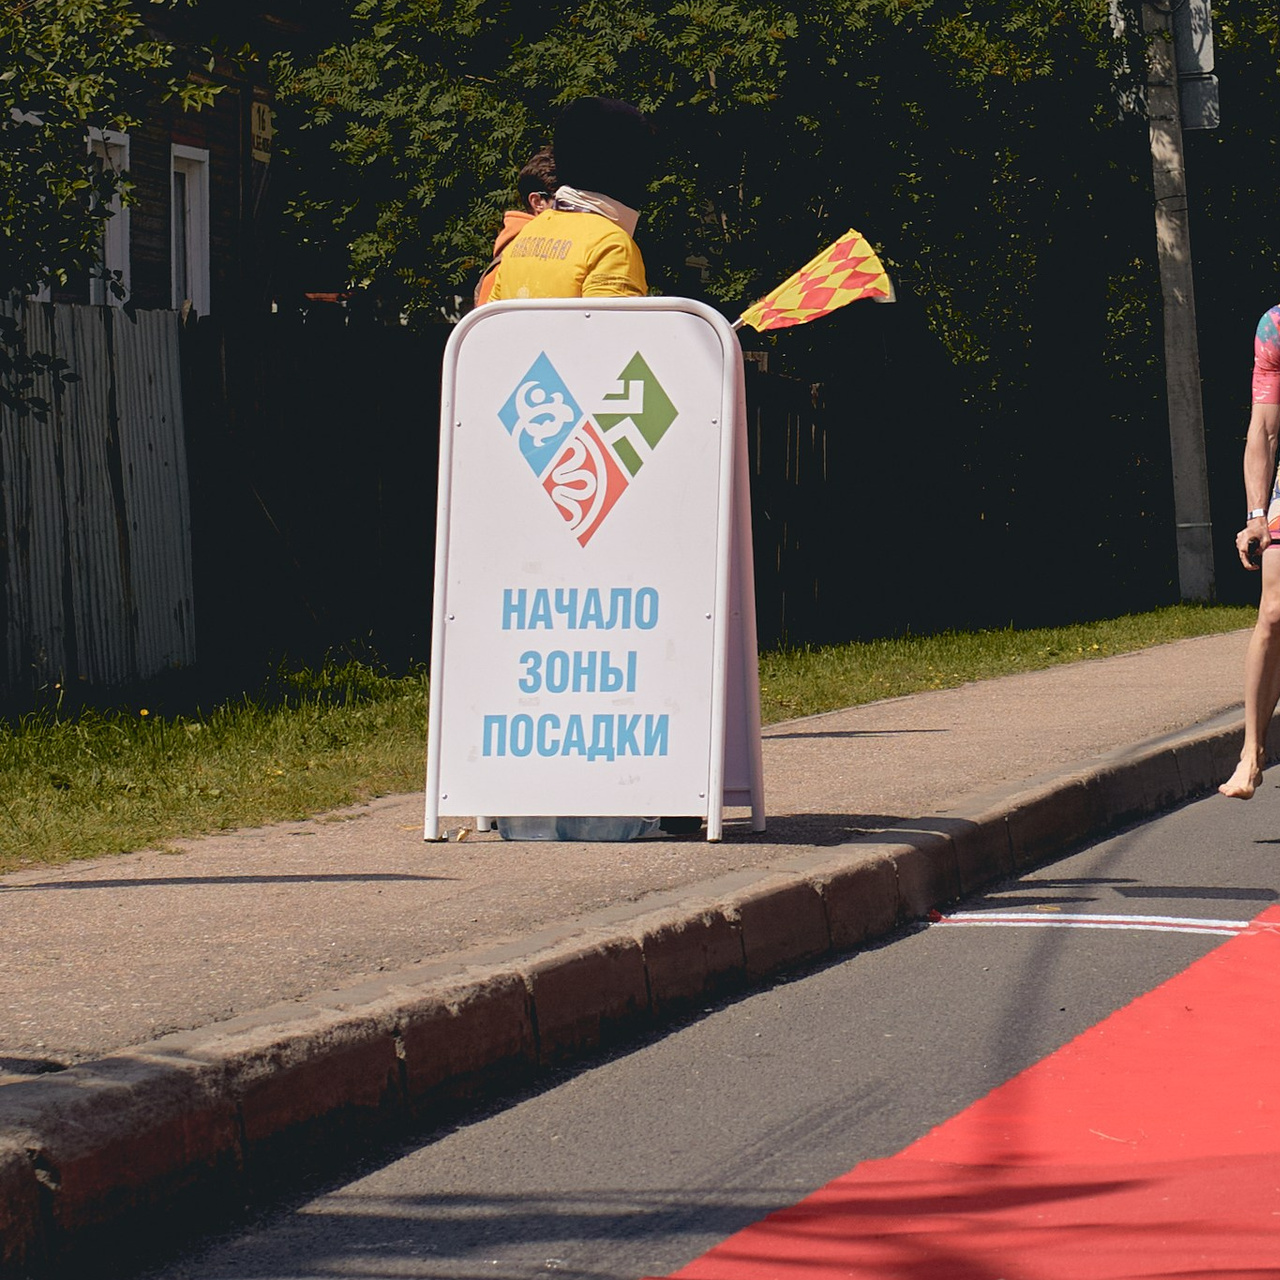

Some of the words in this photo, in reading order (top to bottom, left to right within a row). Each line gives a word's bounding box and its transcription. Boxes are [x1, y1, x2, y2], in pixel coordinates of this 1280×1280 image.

[502, 587, 659, 631] НАЧАЛО
[518, 650, 637, 693] ЗОНЫ
[482, 714, 670, 761] ПОСАДКИ
